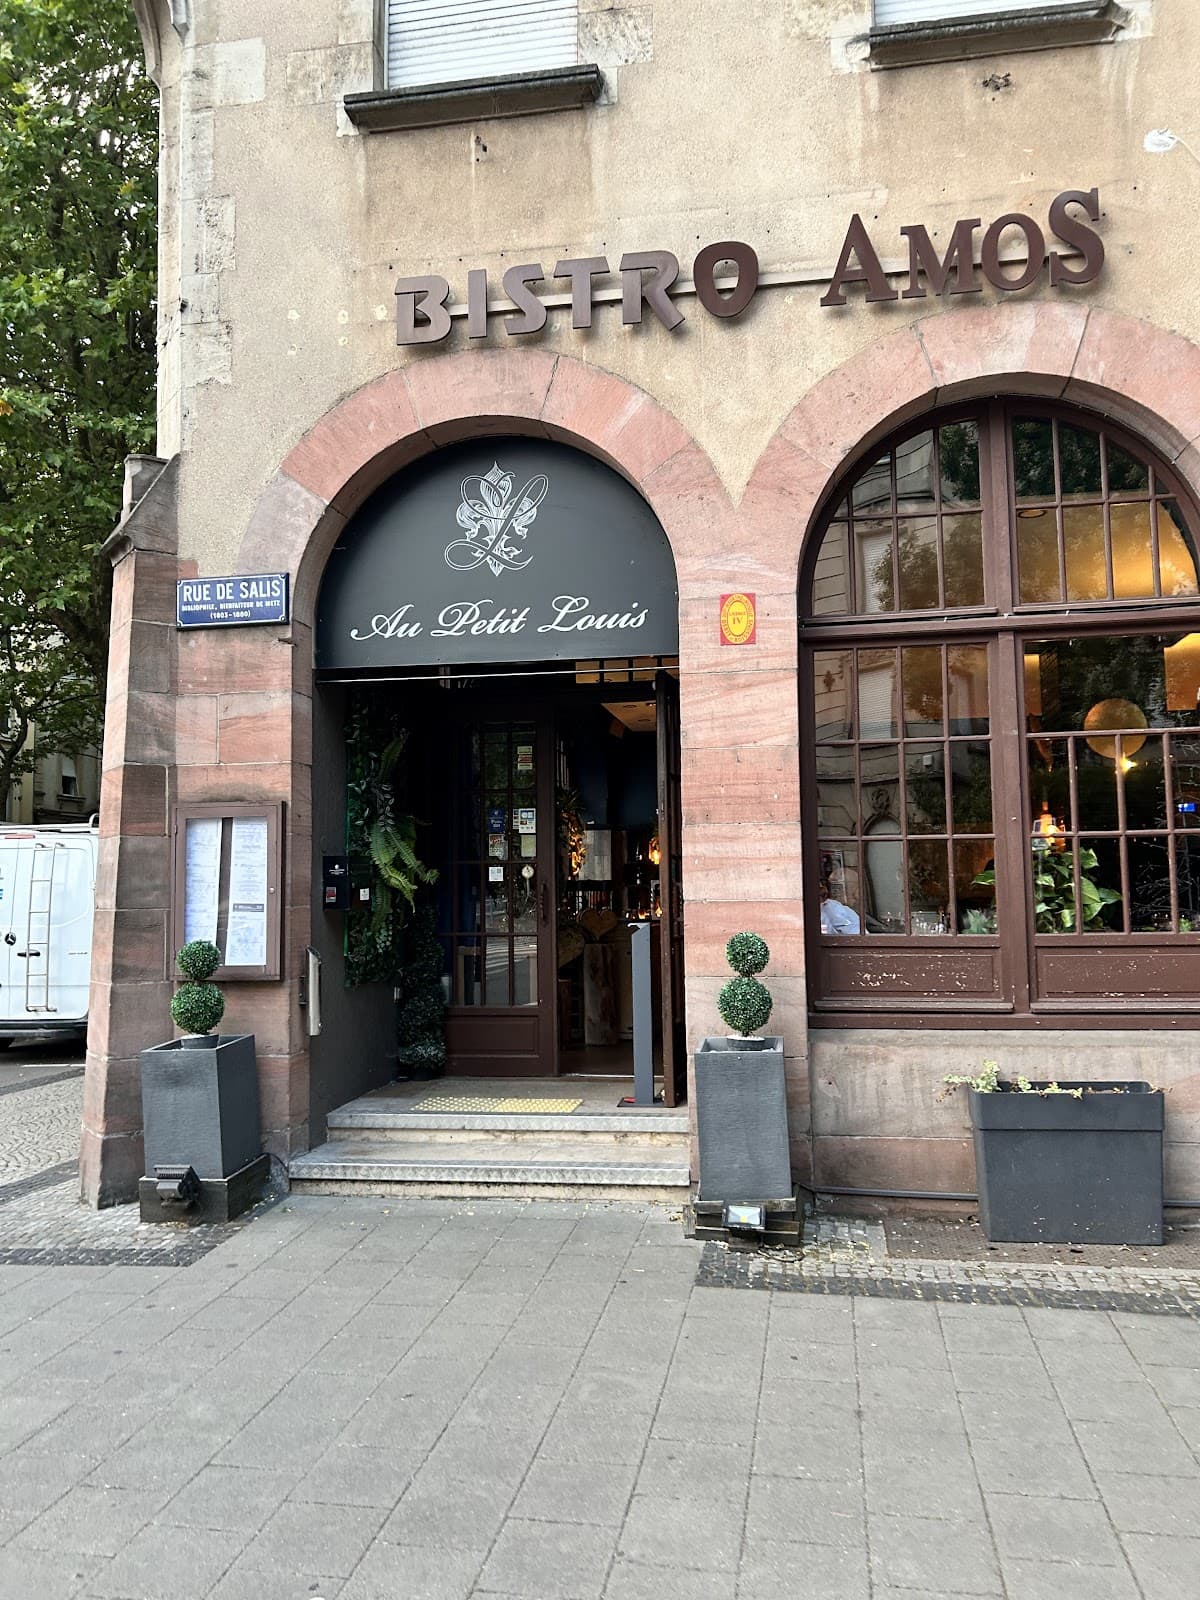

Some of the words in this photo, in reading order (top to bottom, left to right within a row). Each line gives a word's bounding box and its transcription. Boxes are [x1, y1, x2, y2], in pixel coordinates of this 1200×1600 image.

[396, 241, 760, 346] BISTRO
[820, 187, 1106, 307] AMOS
[183, 584, 211, 602] RUE
[217, 582, 235, 600] DE
[240, 580, 281, 599] SALIS
[350, 603, 424, 641] Au
[430, 598, 531, 637] Petit
[536, 595, 650, 633] Louis
